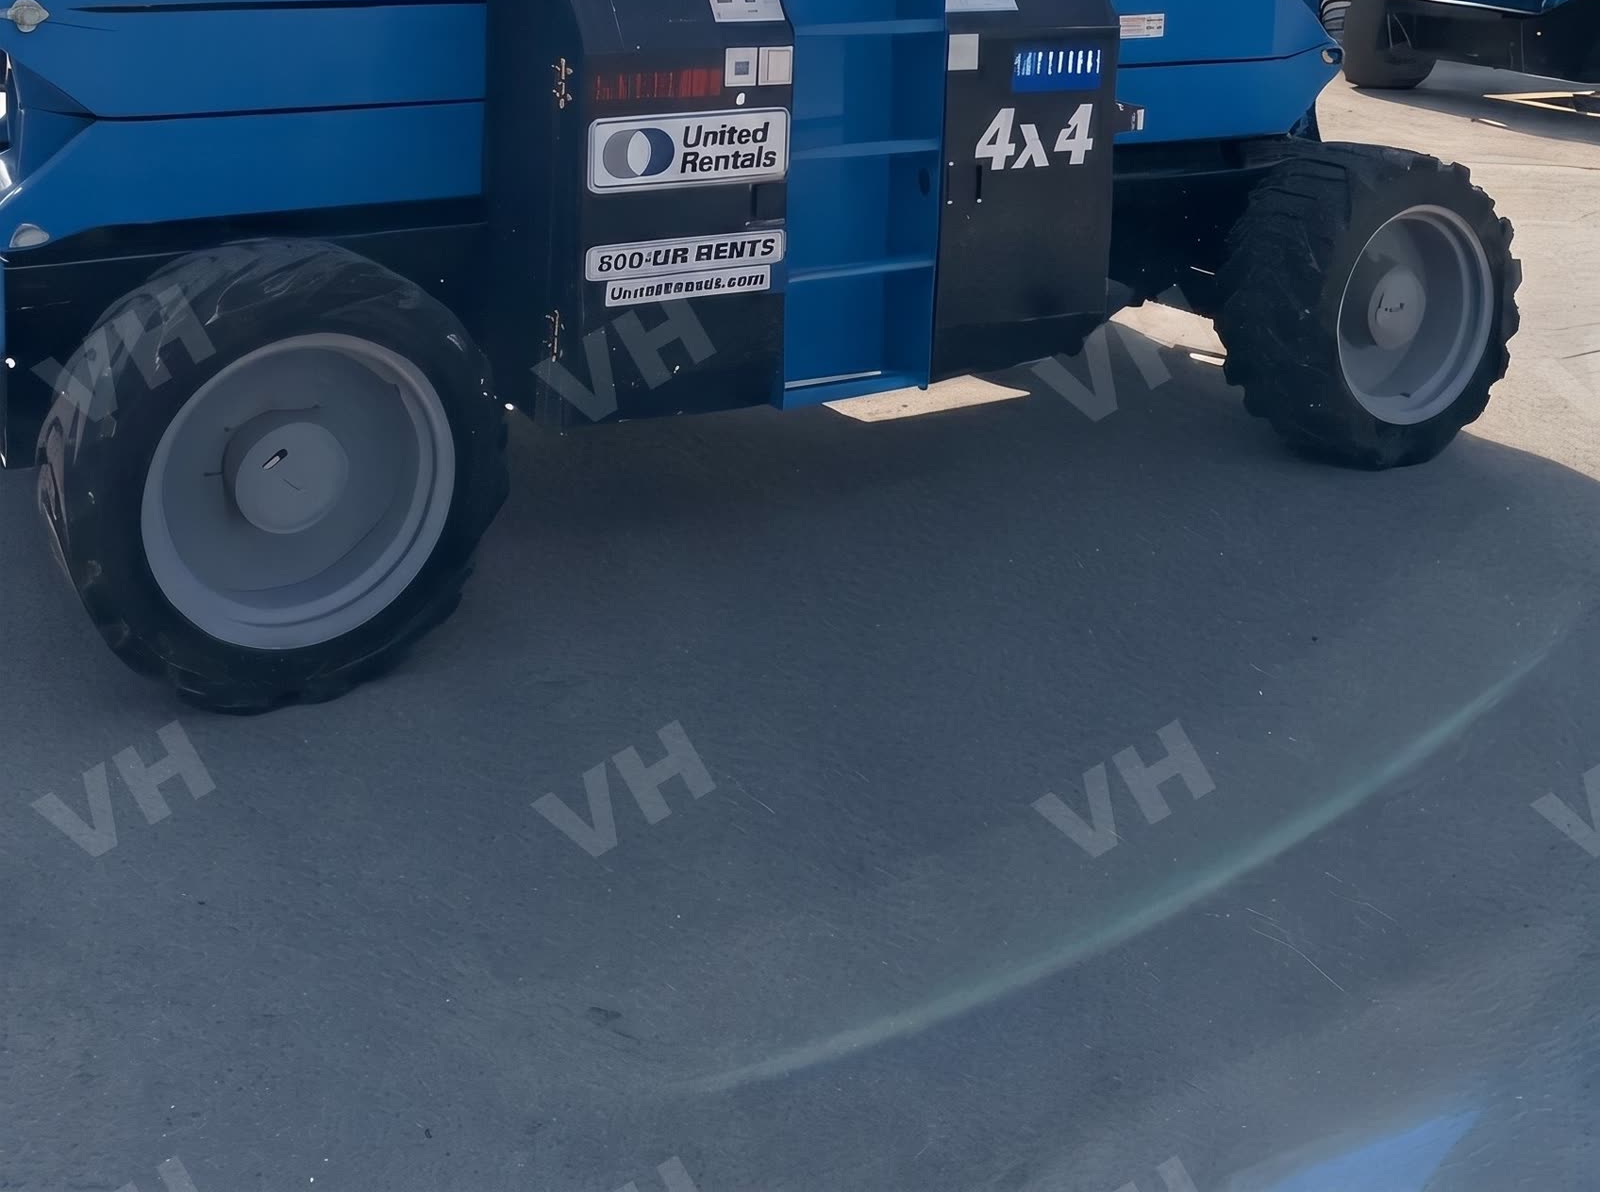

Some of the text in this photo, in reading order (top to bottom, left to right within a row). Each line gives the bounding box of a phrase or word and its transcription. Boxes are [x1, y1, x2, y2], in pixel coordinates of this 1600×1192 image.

[682, 121, 770, 149] United
[974, 104, 1094, 171] 4x4
[680, 145, 777, 174] Rentals
